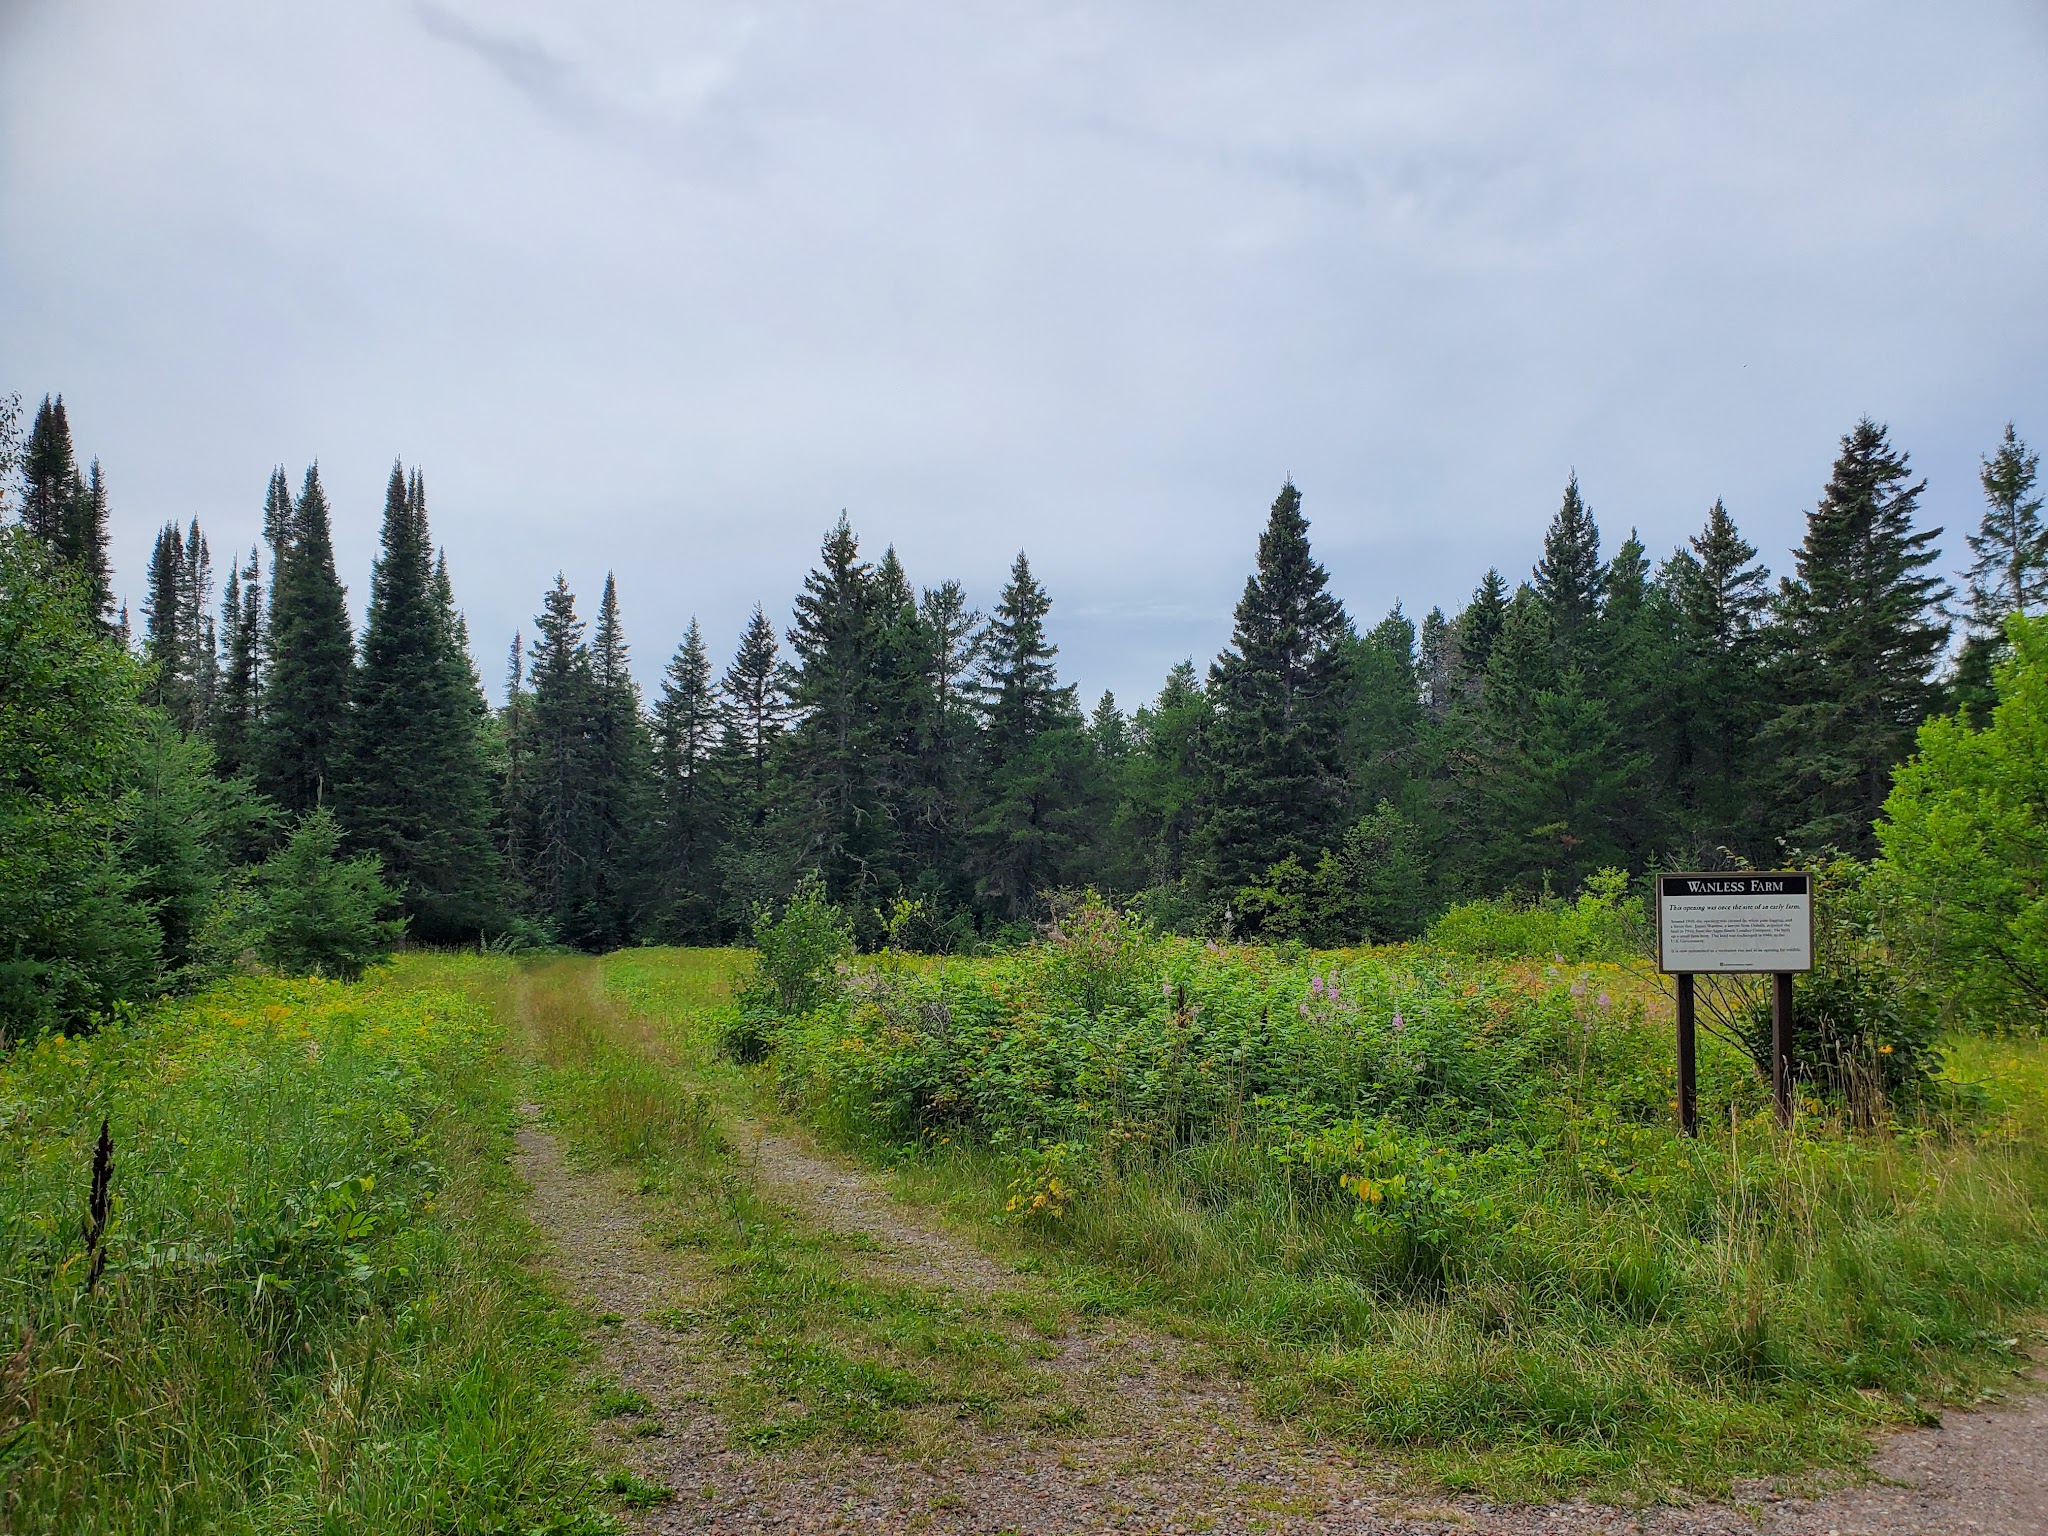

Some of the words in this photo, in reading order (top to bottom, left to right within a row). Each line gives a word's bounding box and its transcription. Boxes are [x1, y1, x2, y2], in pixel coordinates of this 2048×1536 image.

[1687, 881, 1745, 892] WANLESS
[1751, 880, 1783, 891] FARM
[1769, 903, 1785, 911] early
